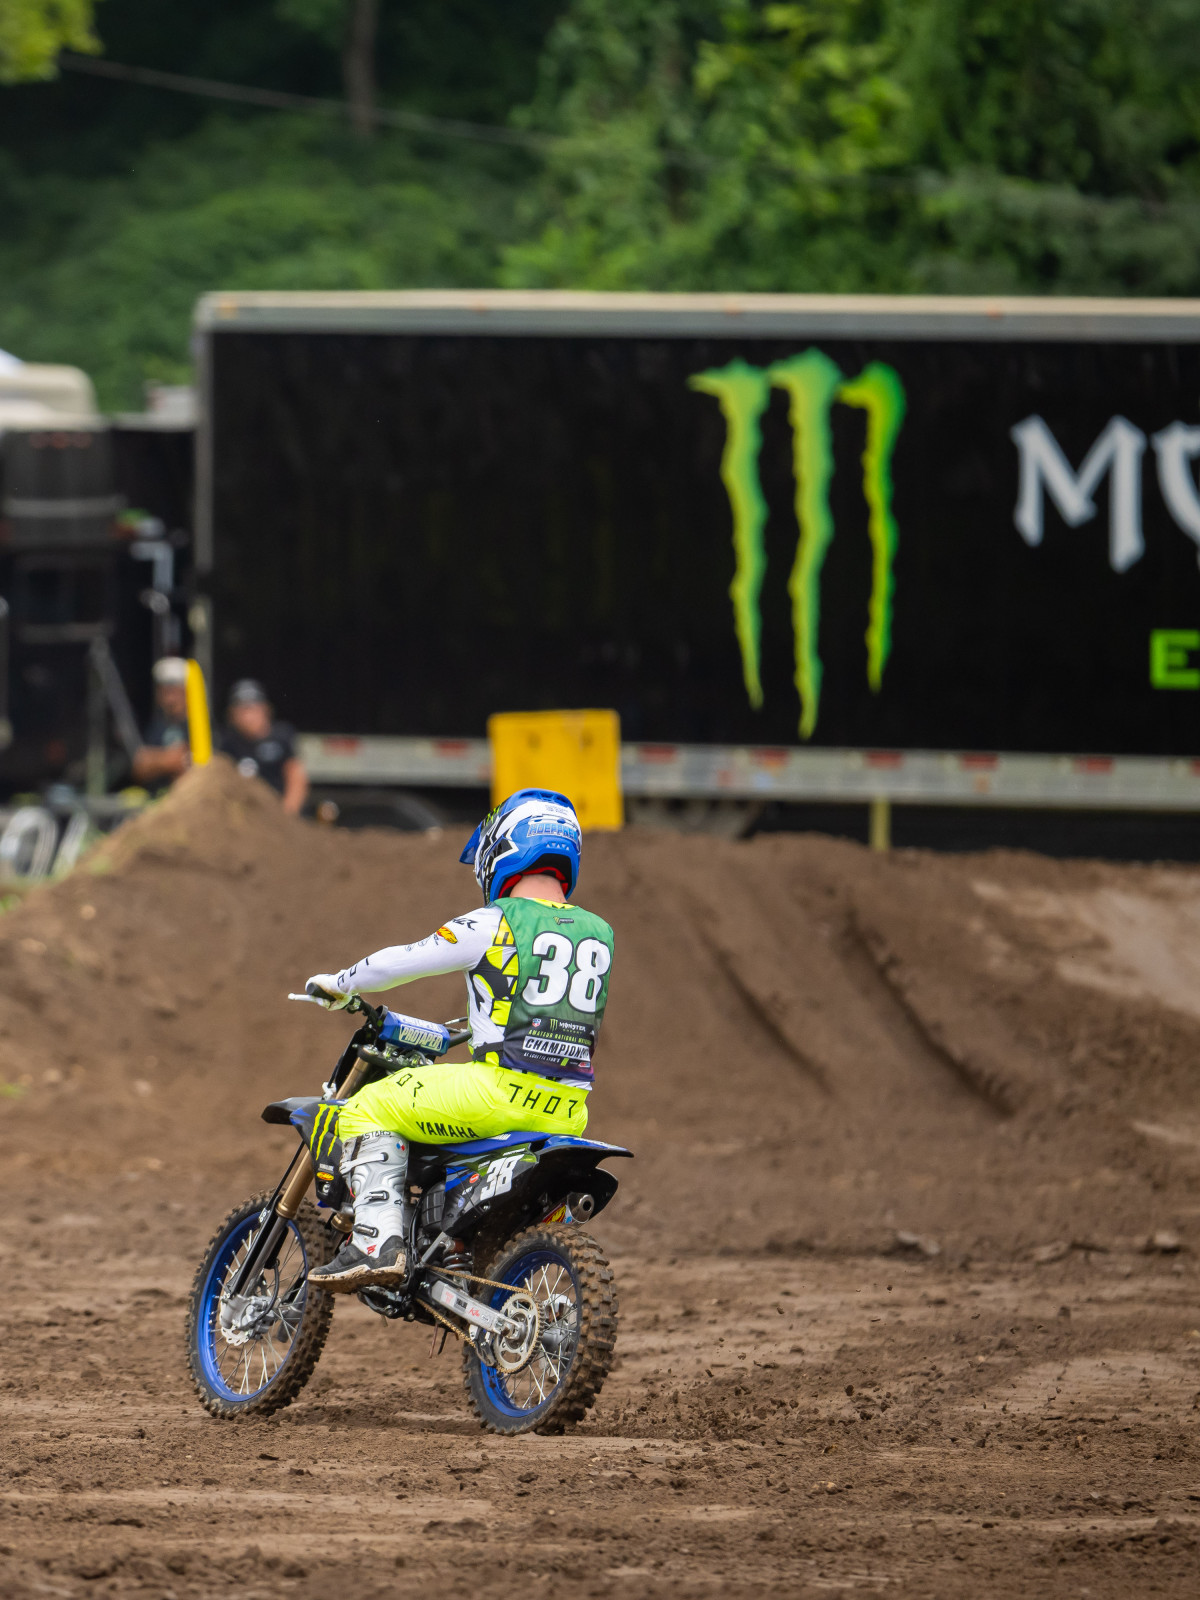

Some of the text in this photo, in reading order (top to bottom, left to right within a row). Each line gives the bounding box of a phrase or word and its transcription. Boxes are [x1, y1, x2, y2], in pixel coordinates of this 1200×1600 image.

[521, 930, 612, 1014] 38
[528, 1029, 553, 1039] AMATEUR
[554, 1033, 577, 1042] NATIONAL
[559, 1021, 586, 1032] MONSTER
[400, 1026, 442, 1051] PROTAPER
[415, 1121, 480, 1139] YAMAHA
[480, 1153, 525, 1201] 38
